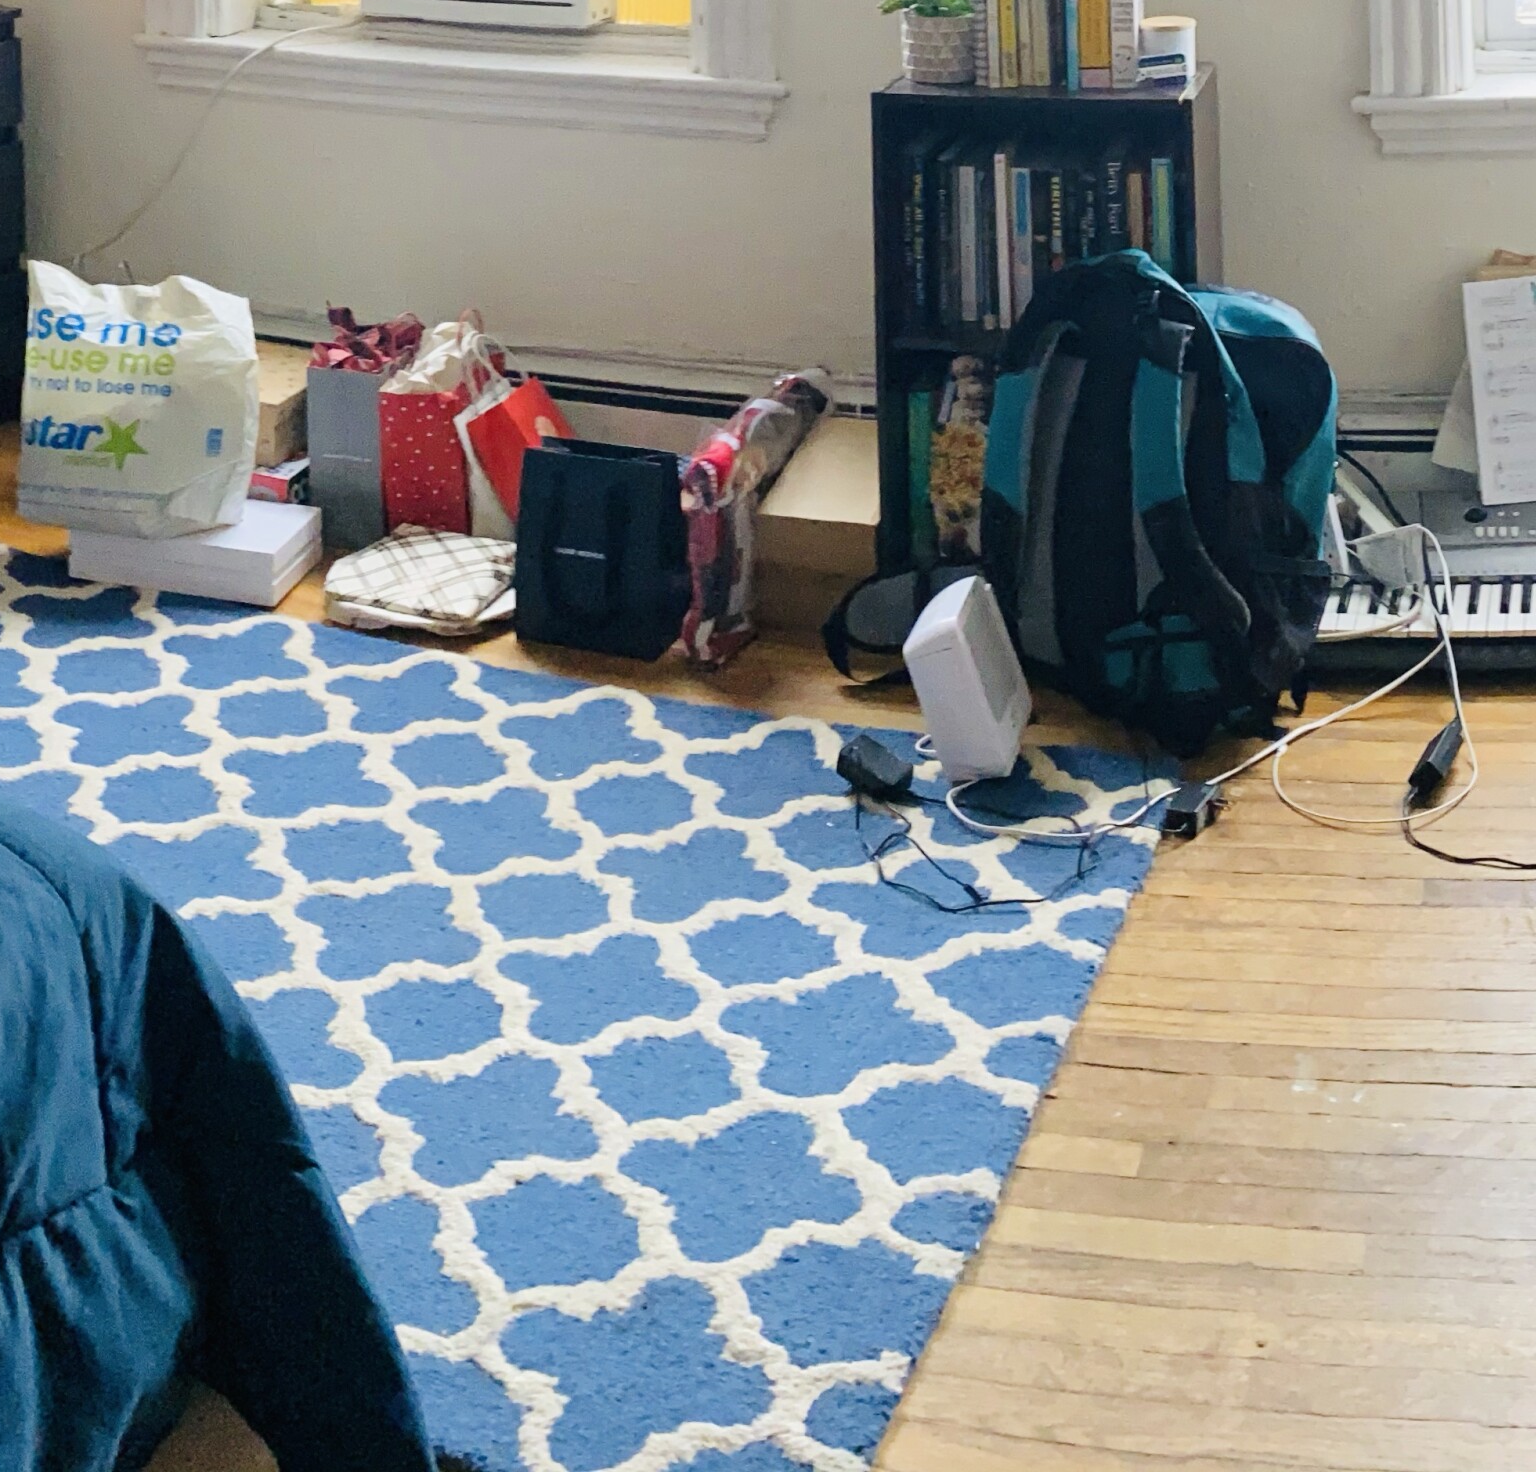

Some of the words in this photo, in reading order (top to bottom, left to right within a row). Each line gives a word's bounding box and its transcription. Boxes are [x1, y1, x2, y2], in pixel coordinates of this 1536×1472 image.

[100, 323, 181, 347] me
[118, 351, 176, 376] me
[75, 378, 91, 394] to
[96, 378, 135, 396] lose
[141, 383, 173, 397] me
